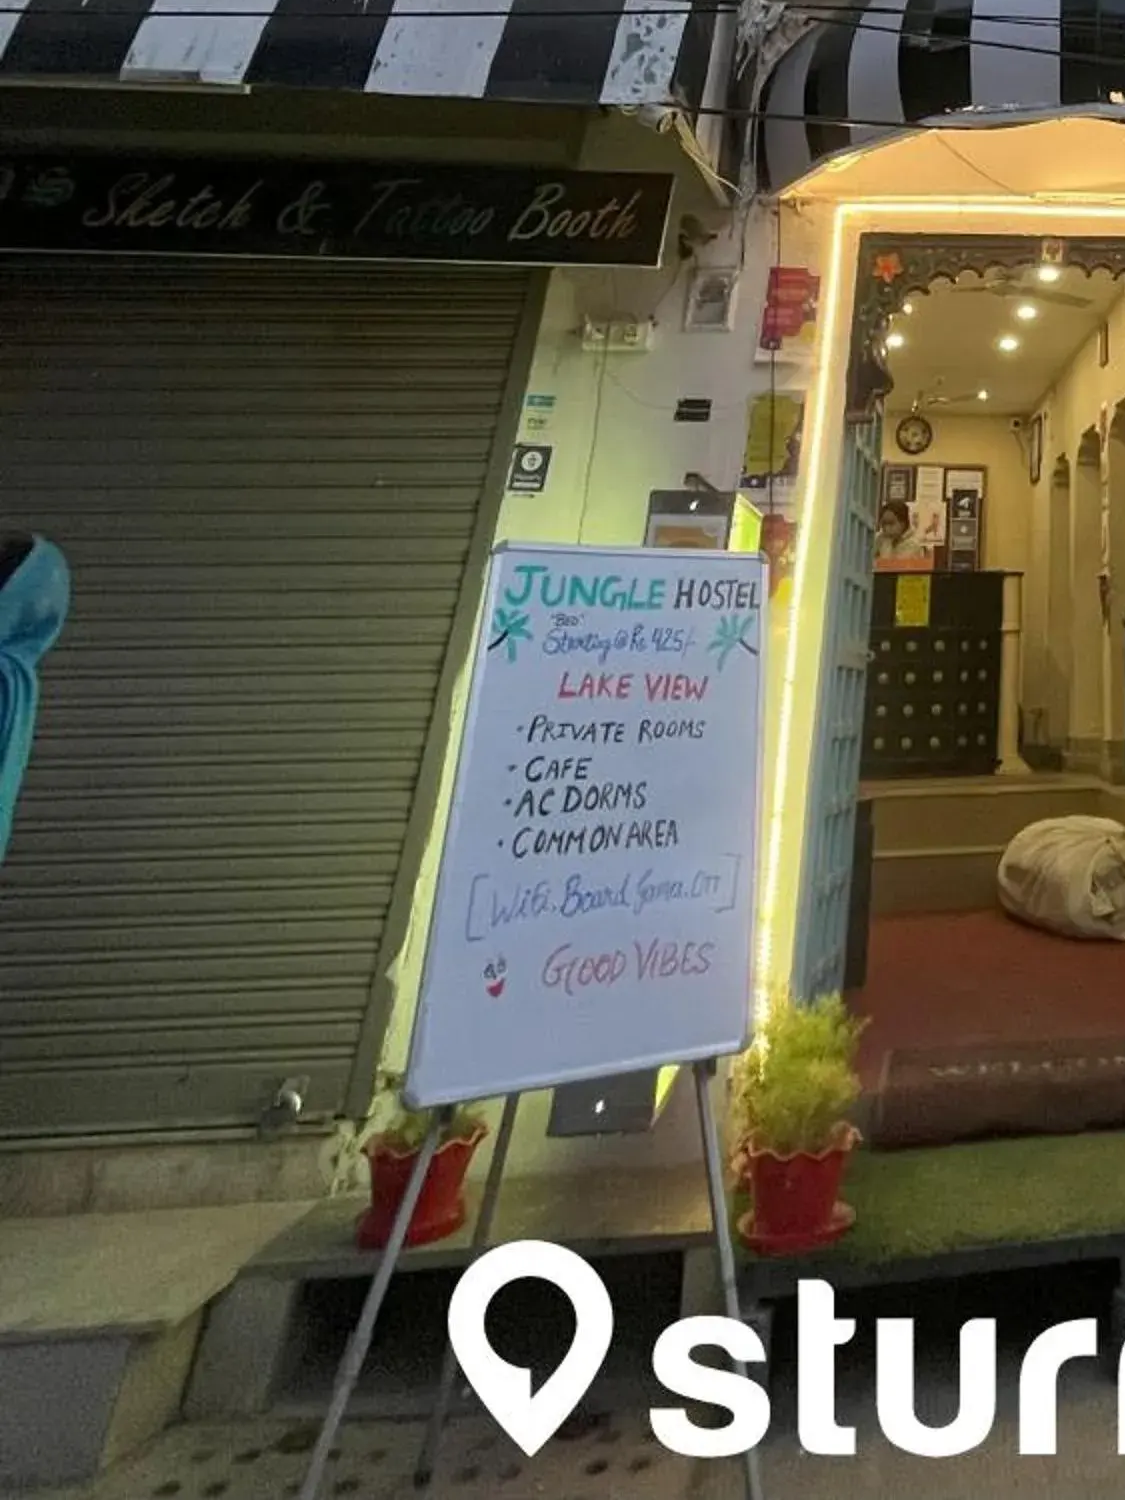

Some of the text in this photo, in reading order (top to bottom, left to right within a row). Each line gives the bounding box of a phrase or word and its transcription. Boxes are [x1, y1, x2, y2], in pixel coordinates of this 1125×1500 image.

[82, 171, 641, 241] Sketch & Tattoo Booth
[503, 564, 761, 612] JUNGLE HOSTEL
[557, 670, 709, 702] LAKE VIEW
[526, 714, 706, 744] PRIVATE ROOMS
[525, 755, 593, 783] CAFE
[513, 781, 648, 818] AC DORMS
[512, 819, 679, 859] COMMON AREA
[541, 938, 715, 996] GOOD VIBES
